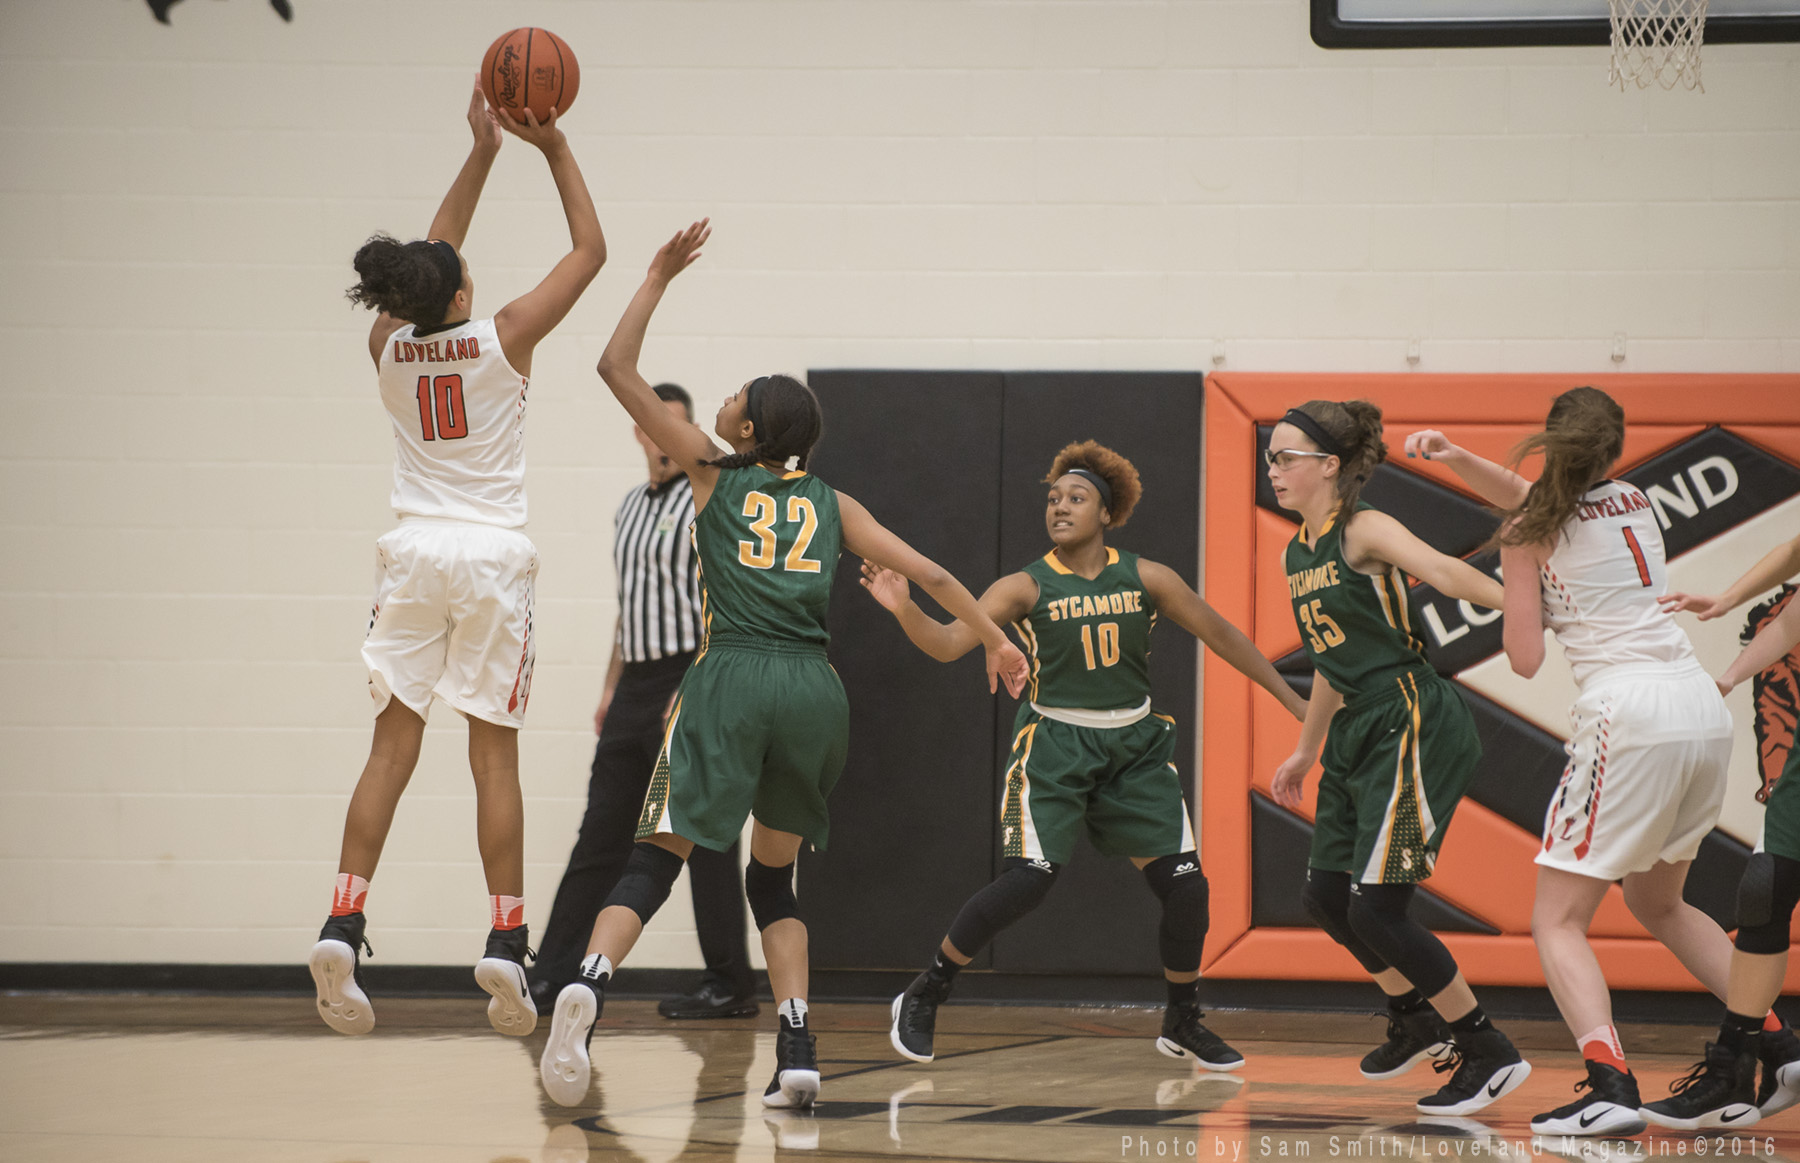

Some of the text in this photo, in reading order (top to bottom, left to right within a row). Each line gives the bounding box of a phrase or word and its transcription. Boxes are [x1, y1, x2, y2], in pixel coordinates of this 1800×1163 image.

[498, 45, 520, 108] Rawlings
[394, 337, 480, 363] LOVELAND
[416, 374, 468, 441] 10
[739, 490, 821, 573] 32
[1622, 526, 1652, 587] 1
[1048, 591, 1142, 621] SYCAMORE
[1299, 599, 1346, 654] 35
[1081, 622, 1120, 670] 10
